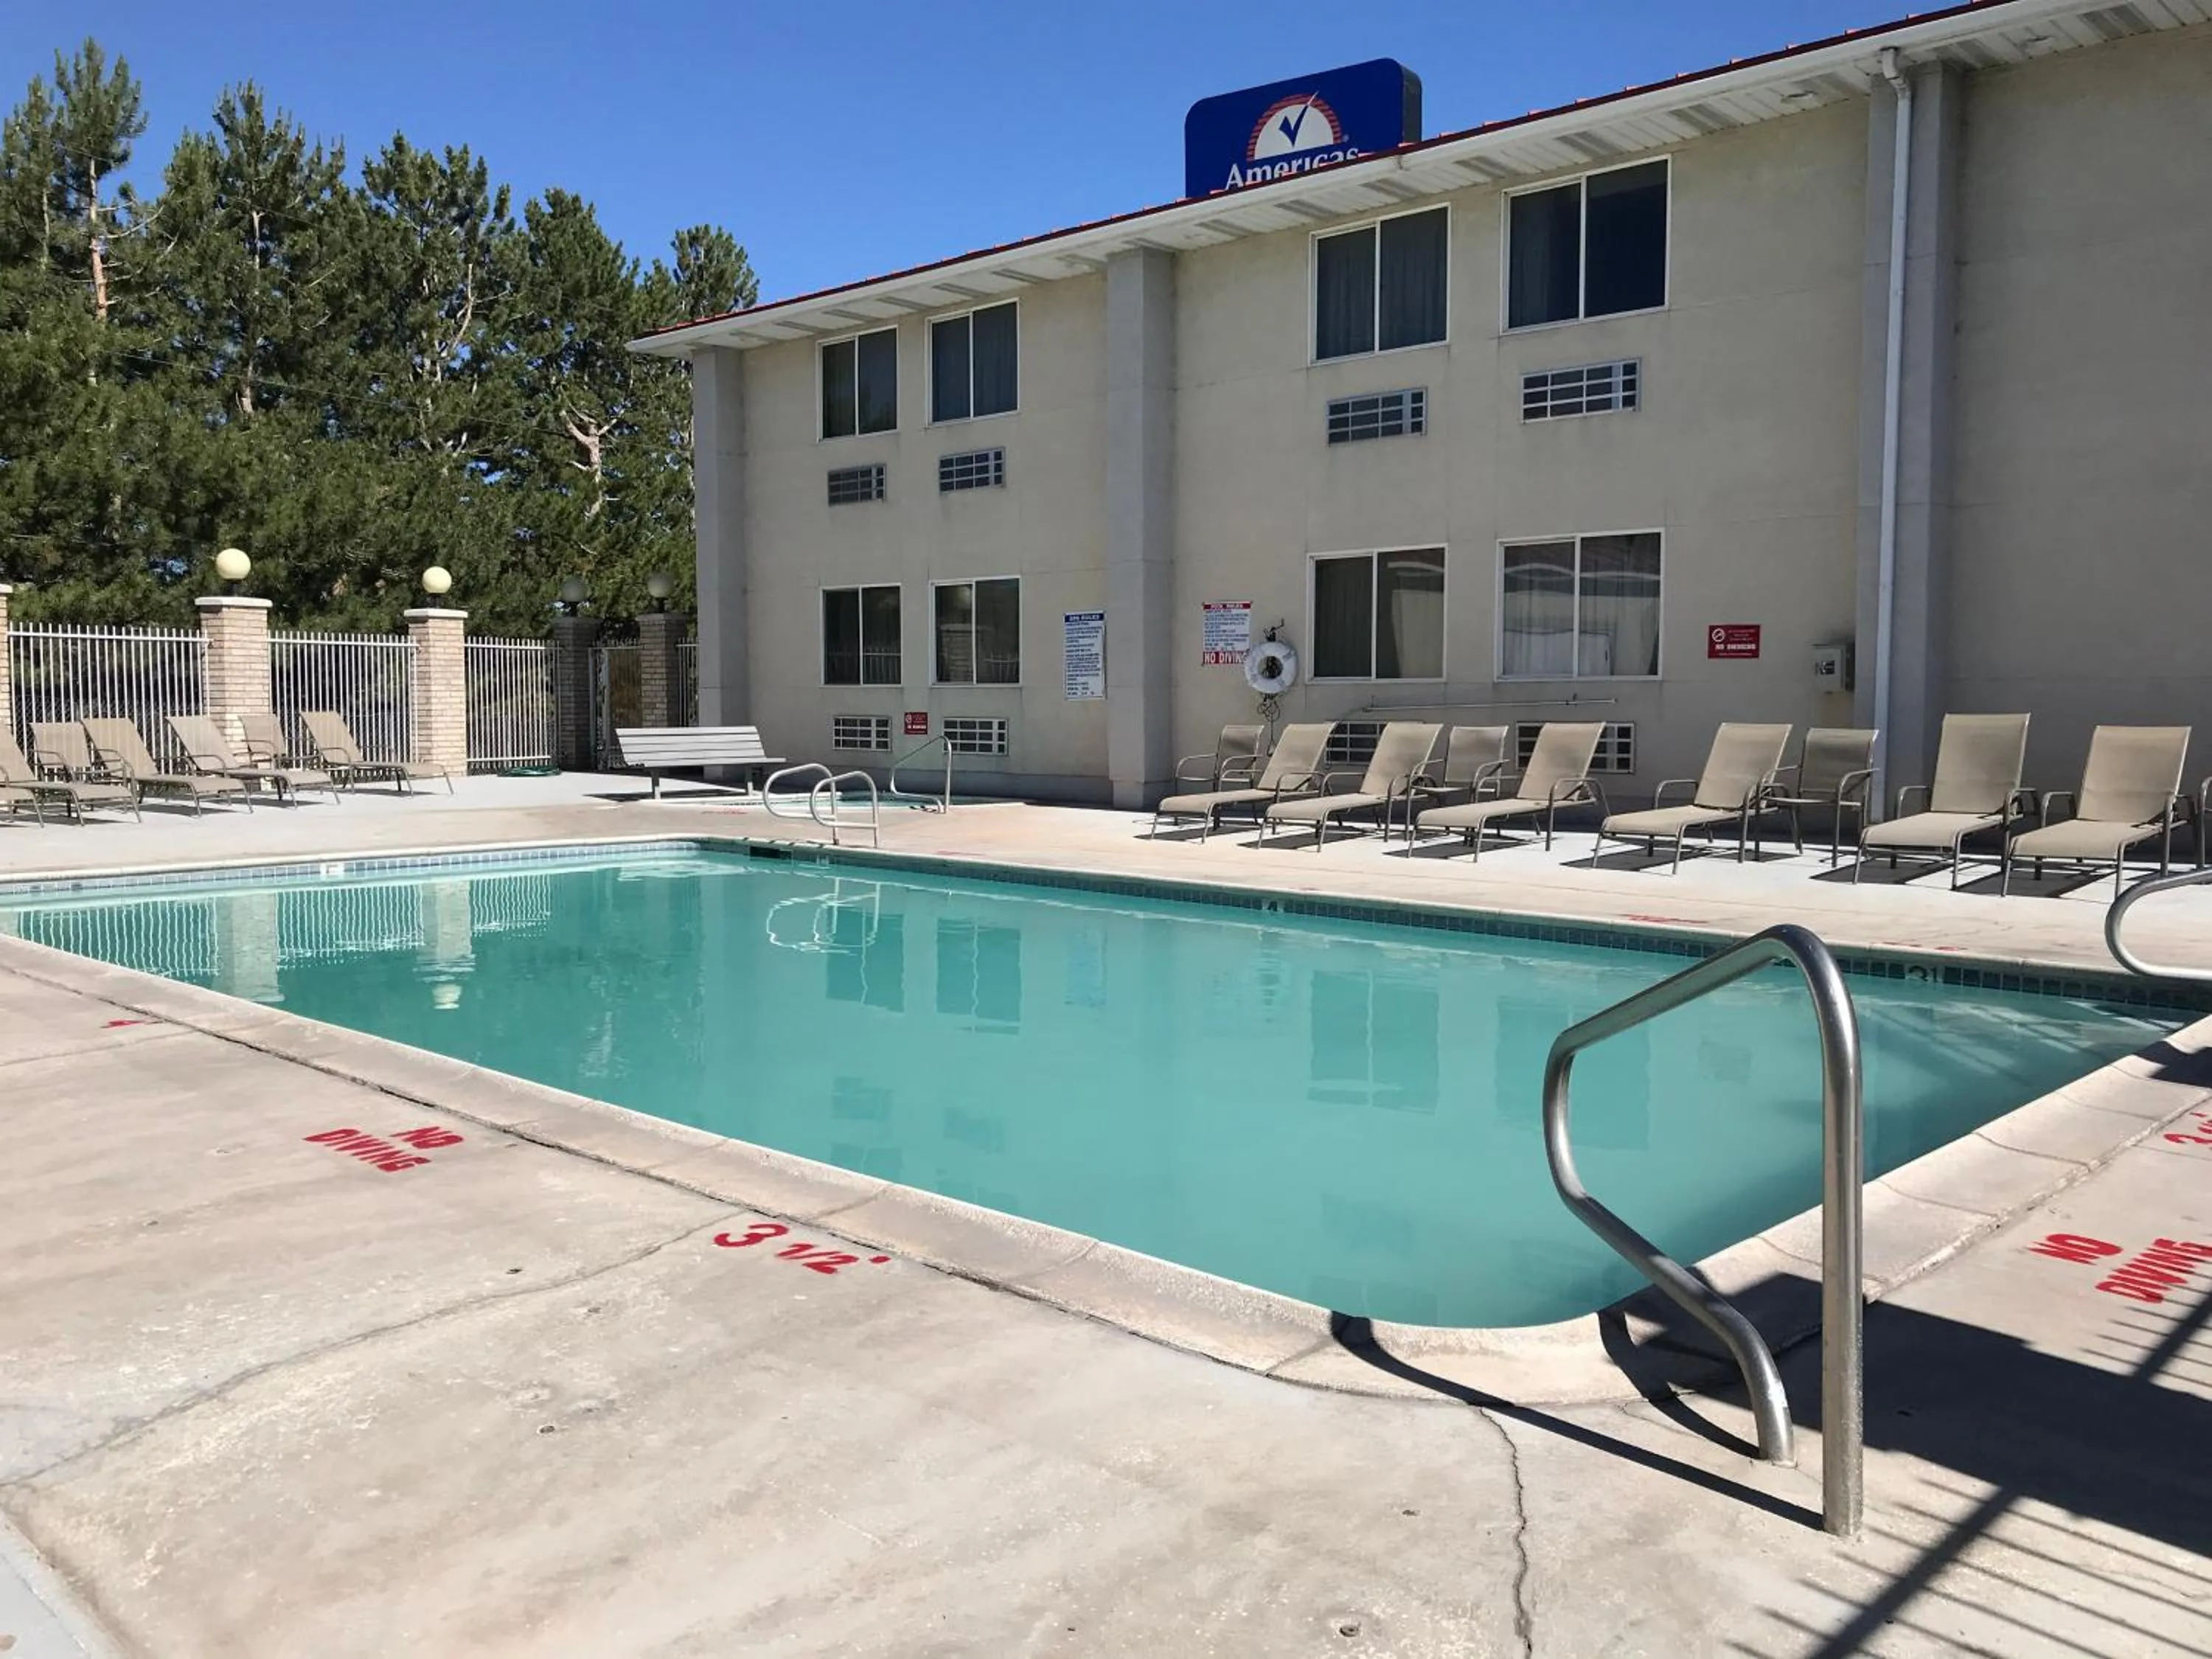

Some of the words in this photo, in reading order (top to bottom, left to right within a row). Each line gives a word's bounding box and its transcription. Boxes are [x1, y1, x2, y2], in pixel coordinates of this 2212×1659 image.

[1204, 652, 1216, 663] NO
[302, 1128, 432, 1172] DIVING
[389, 1126, 465, 1150] NO
[713, 1223, 789, 1247] 3
[2028, 1233, 2124, 1265] NO
